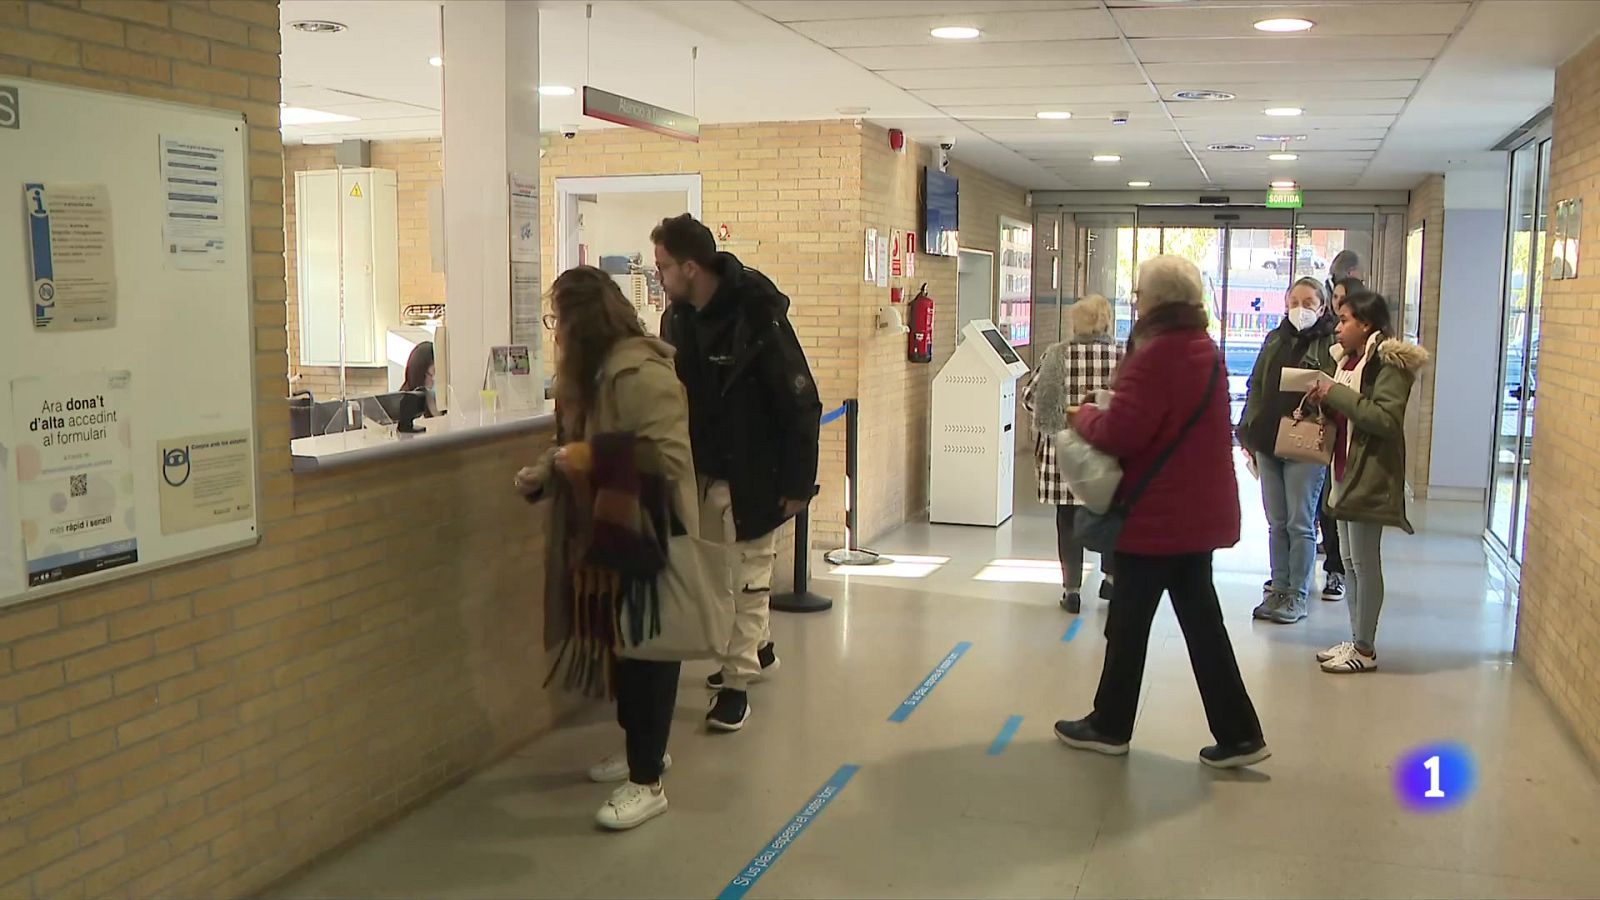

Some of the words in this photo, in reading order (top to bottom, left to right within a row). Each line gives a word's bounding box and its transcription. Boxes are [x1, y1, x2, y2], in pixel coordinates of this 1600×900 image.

[1268, 194, 1300, 203] SORTIDA
[42, 399, 63, 414] Ara
[66, 395, 104, 411] dona't
[29, 416, 65, 432] d'alta
[68, 410, 117, 427] accedint
[43, 433, 54, 447] al
[57, 426, 107, 445] formulari
[89, 515, 112, 528] senzill
[732, 876, 751, 886] Si
[745, 867, 761, 878] us
[771, 822, 802, 849] espereu
